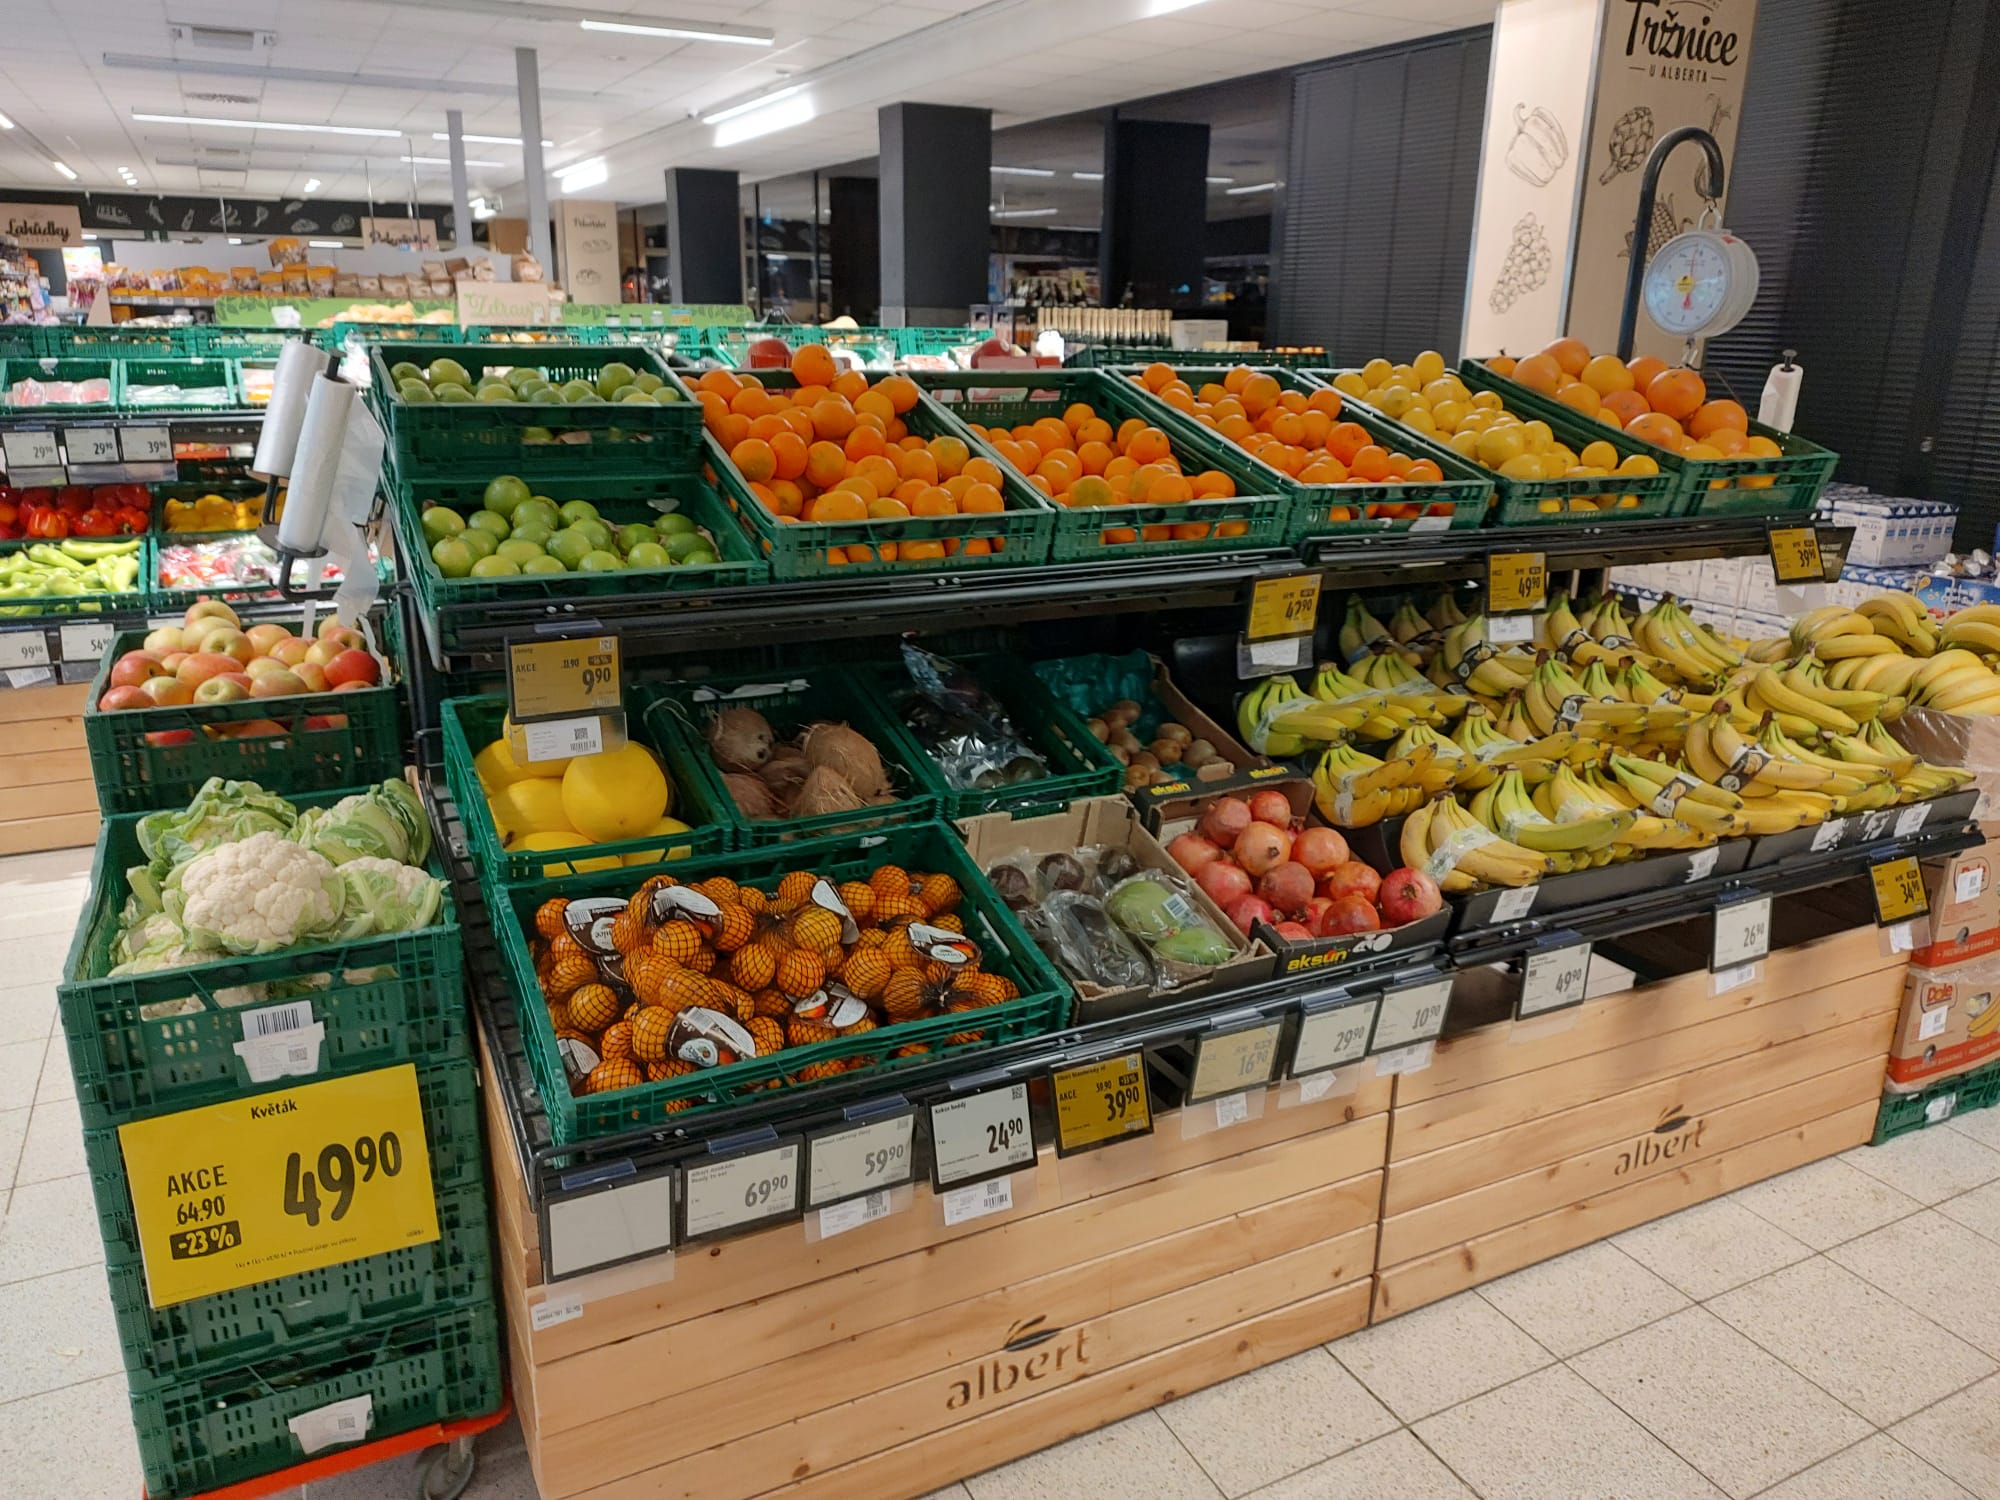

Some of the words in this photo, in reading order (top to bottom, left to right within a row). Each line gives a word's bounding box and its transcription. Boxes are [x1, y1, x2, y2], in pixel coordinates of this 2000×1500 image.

[1625, 0, 1738, 66] Tržnice
[1649, 65, 1657, 77] U
[1661, 66, 1708, 83] ALBERTA
[515, 663, 537, 673] AKCE
[1287, 949, 1348, 971] aksun
[1927, 983, 1953, 1003] Dole
[251, 1099, 298, 1120] Květák
[1613, 1119, 1707, 1175] albert
[167, 1165, 228, 1197] AKCE
[176, 1195, 226, 1225] 64.90
[946, 1328, 1090, 1410] albert
